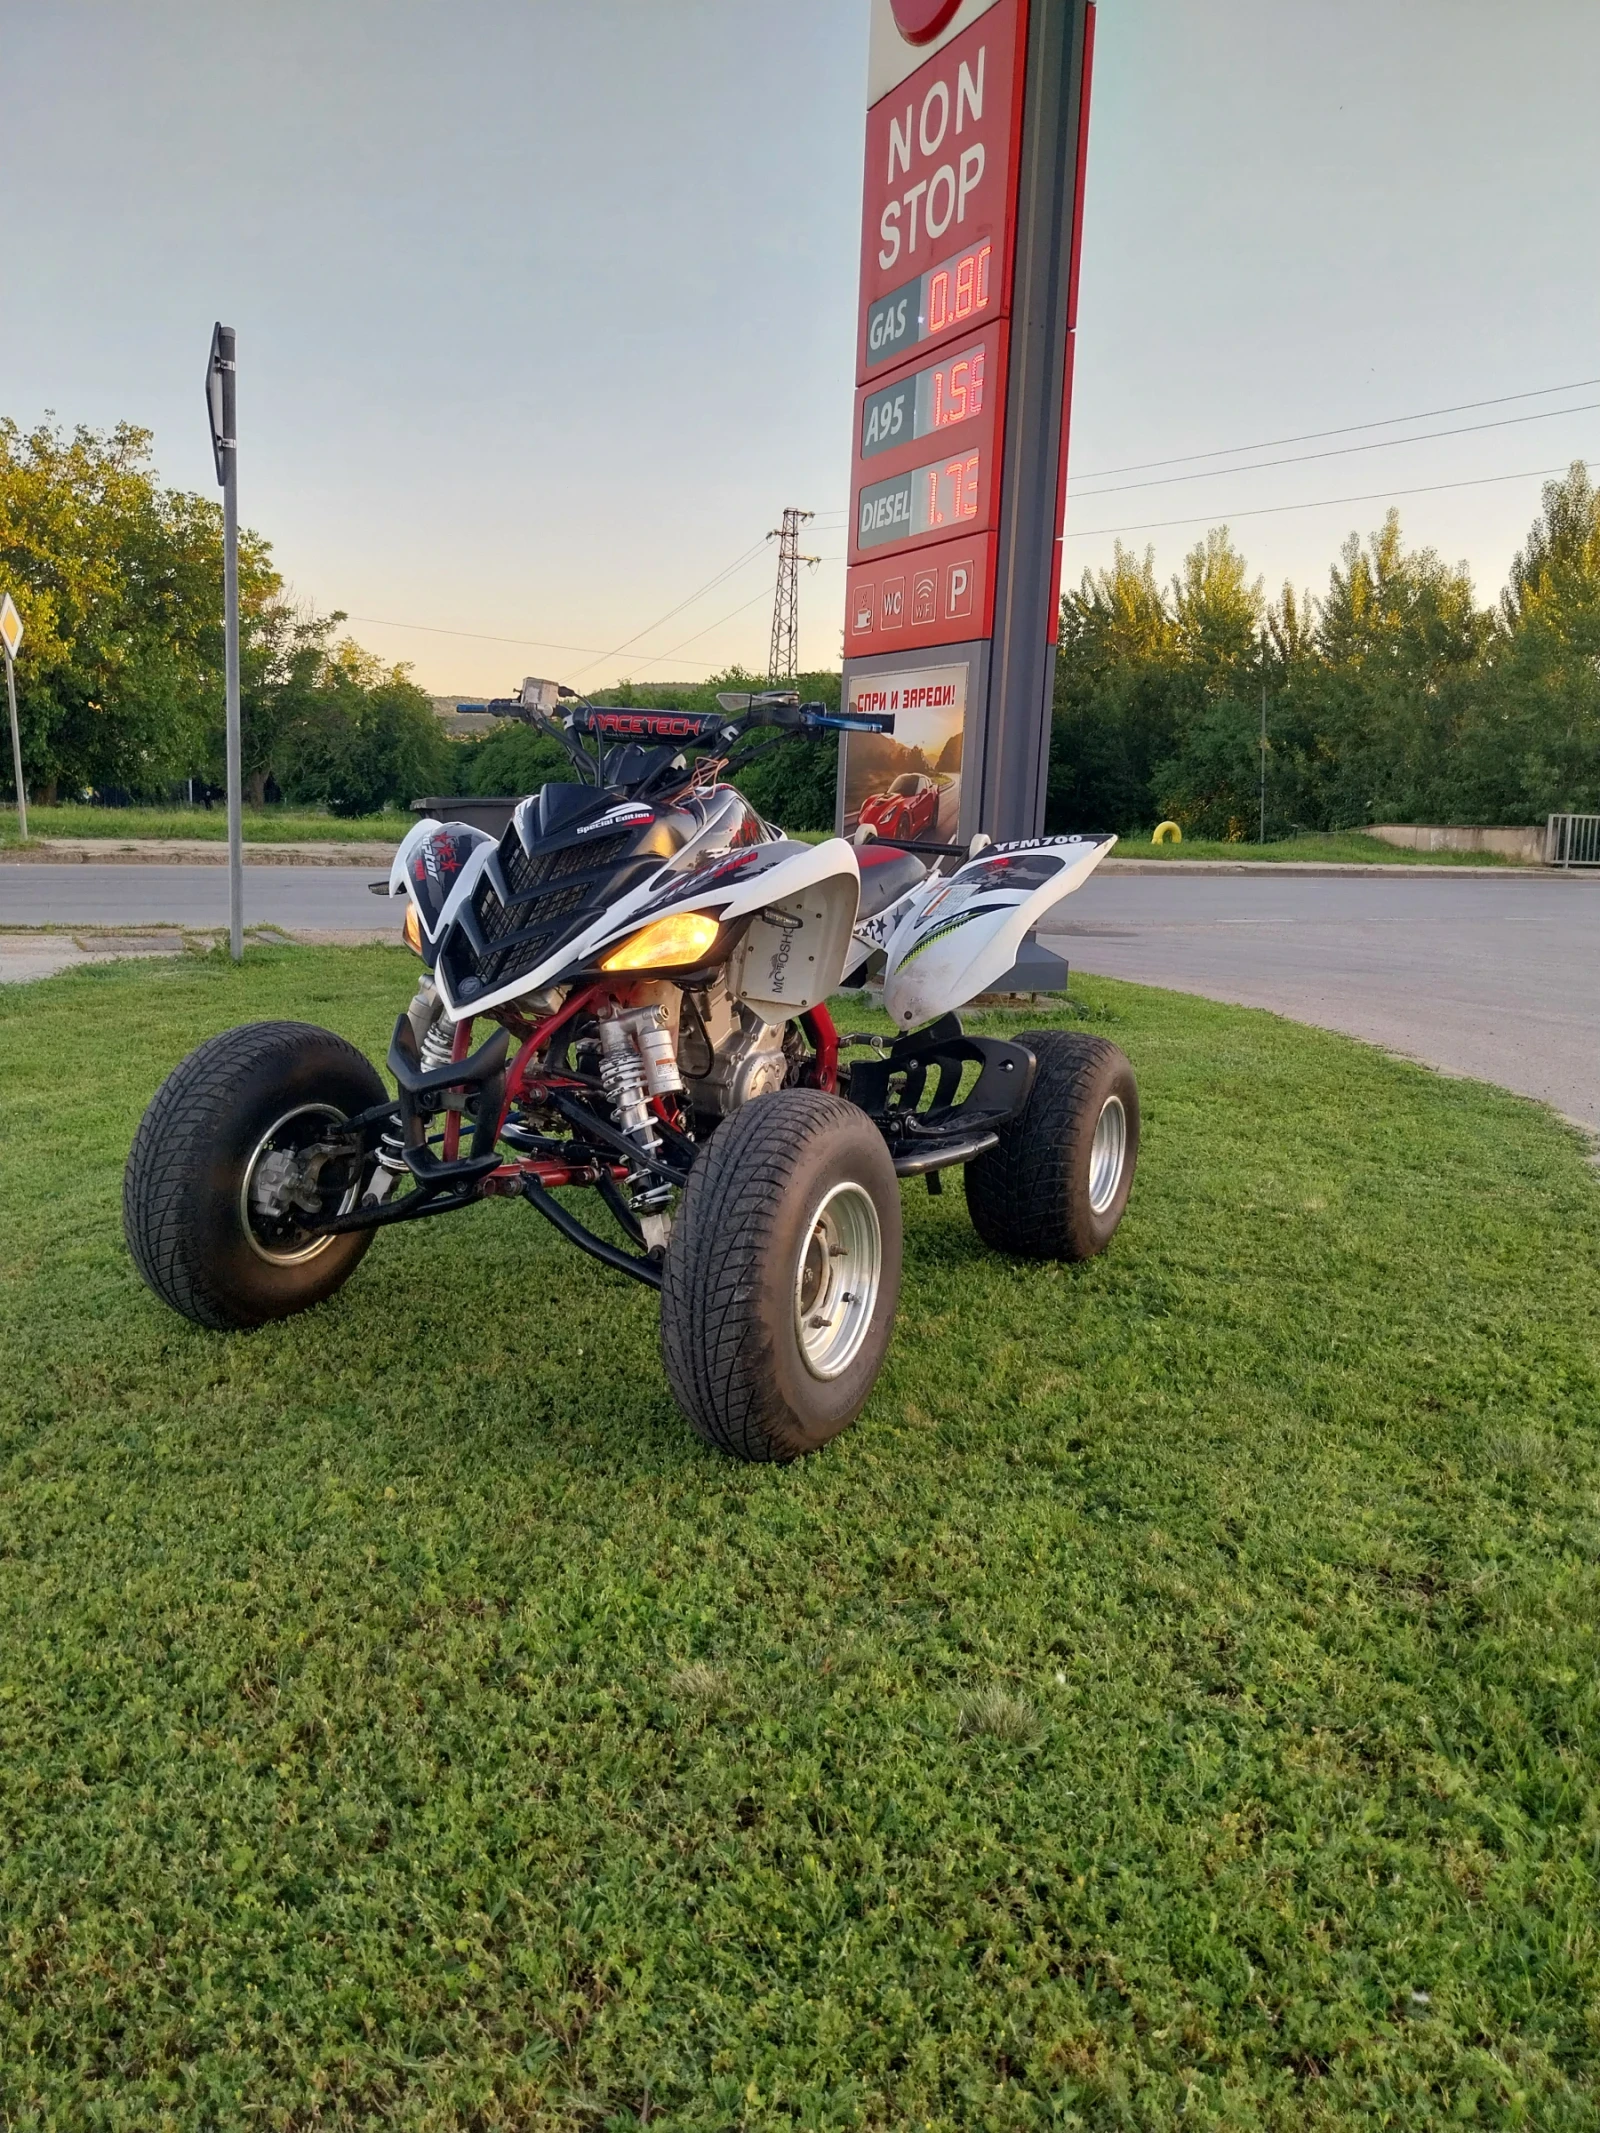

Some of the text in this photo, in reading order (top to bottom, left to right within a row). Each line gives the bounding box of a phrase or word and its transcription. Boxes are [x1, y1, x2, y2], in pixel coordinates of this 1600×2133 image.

[887, 46, 986, 185] NON
[878, 142, 986, 270] STOP
[869, 298, 907, 350] GAS
[865, 394, 905, 446] A95
[861, 490, 910, 533] DIESEL
[884, 592, 902, 616] WC
[950, 569, 967, 611] P
[857, 684, 956, 712] СПРИ И ЗАРЕДИ!
[576, 812, 650, 834] Special Edition
[994, 834, 1082, 853] YFM700
